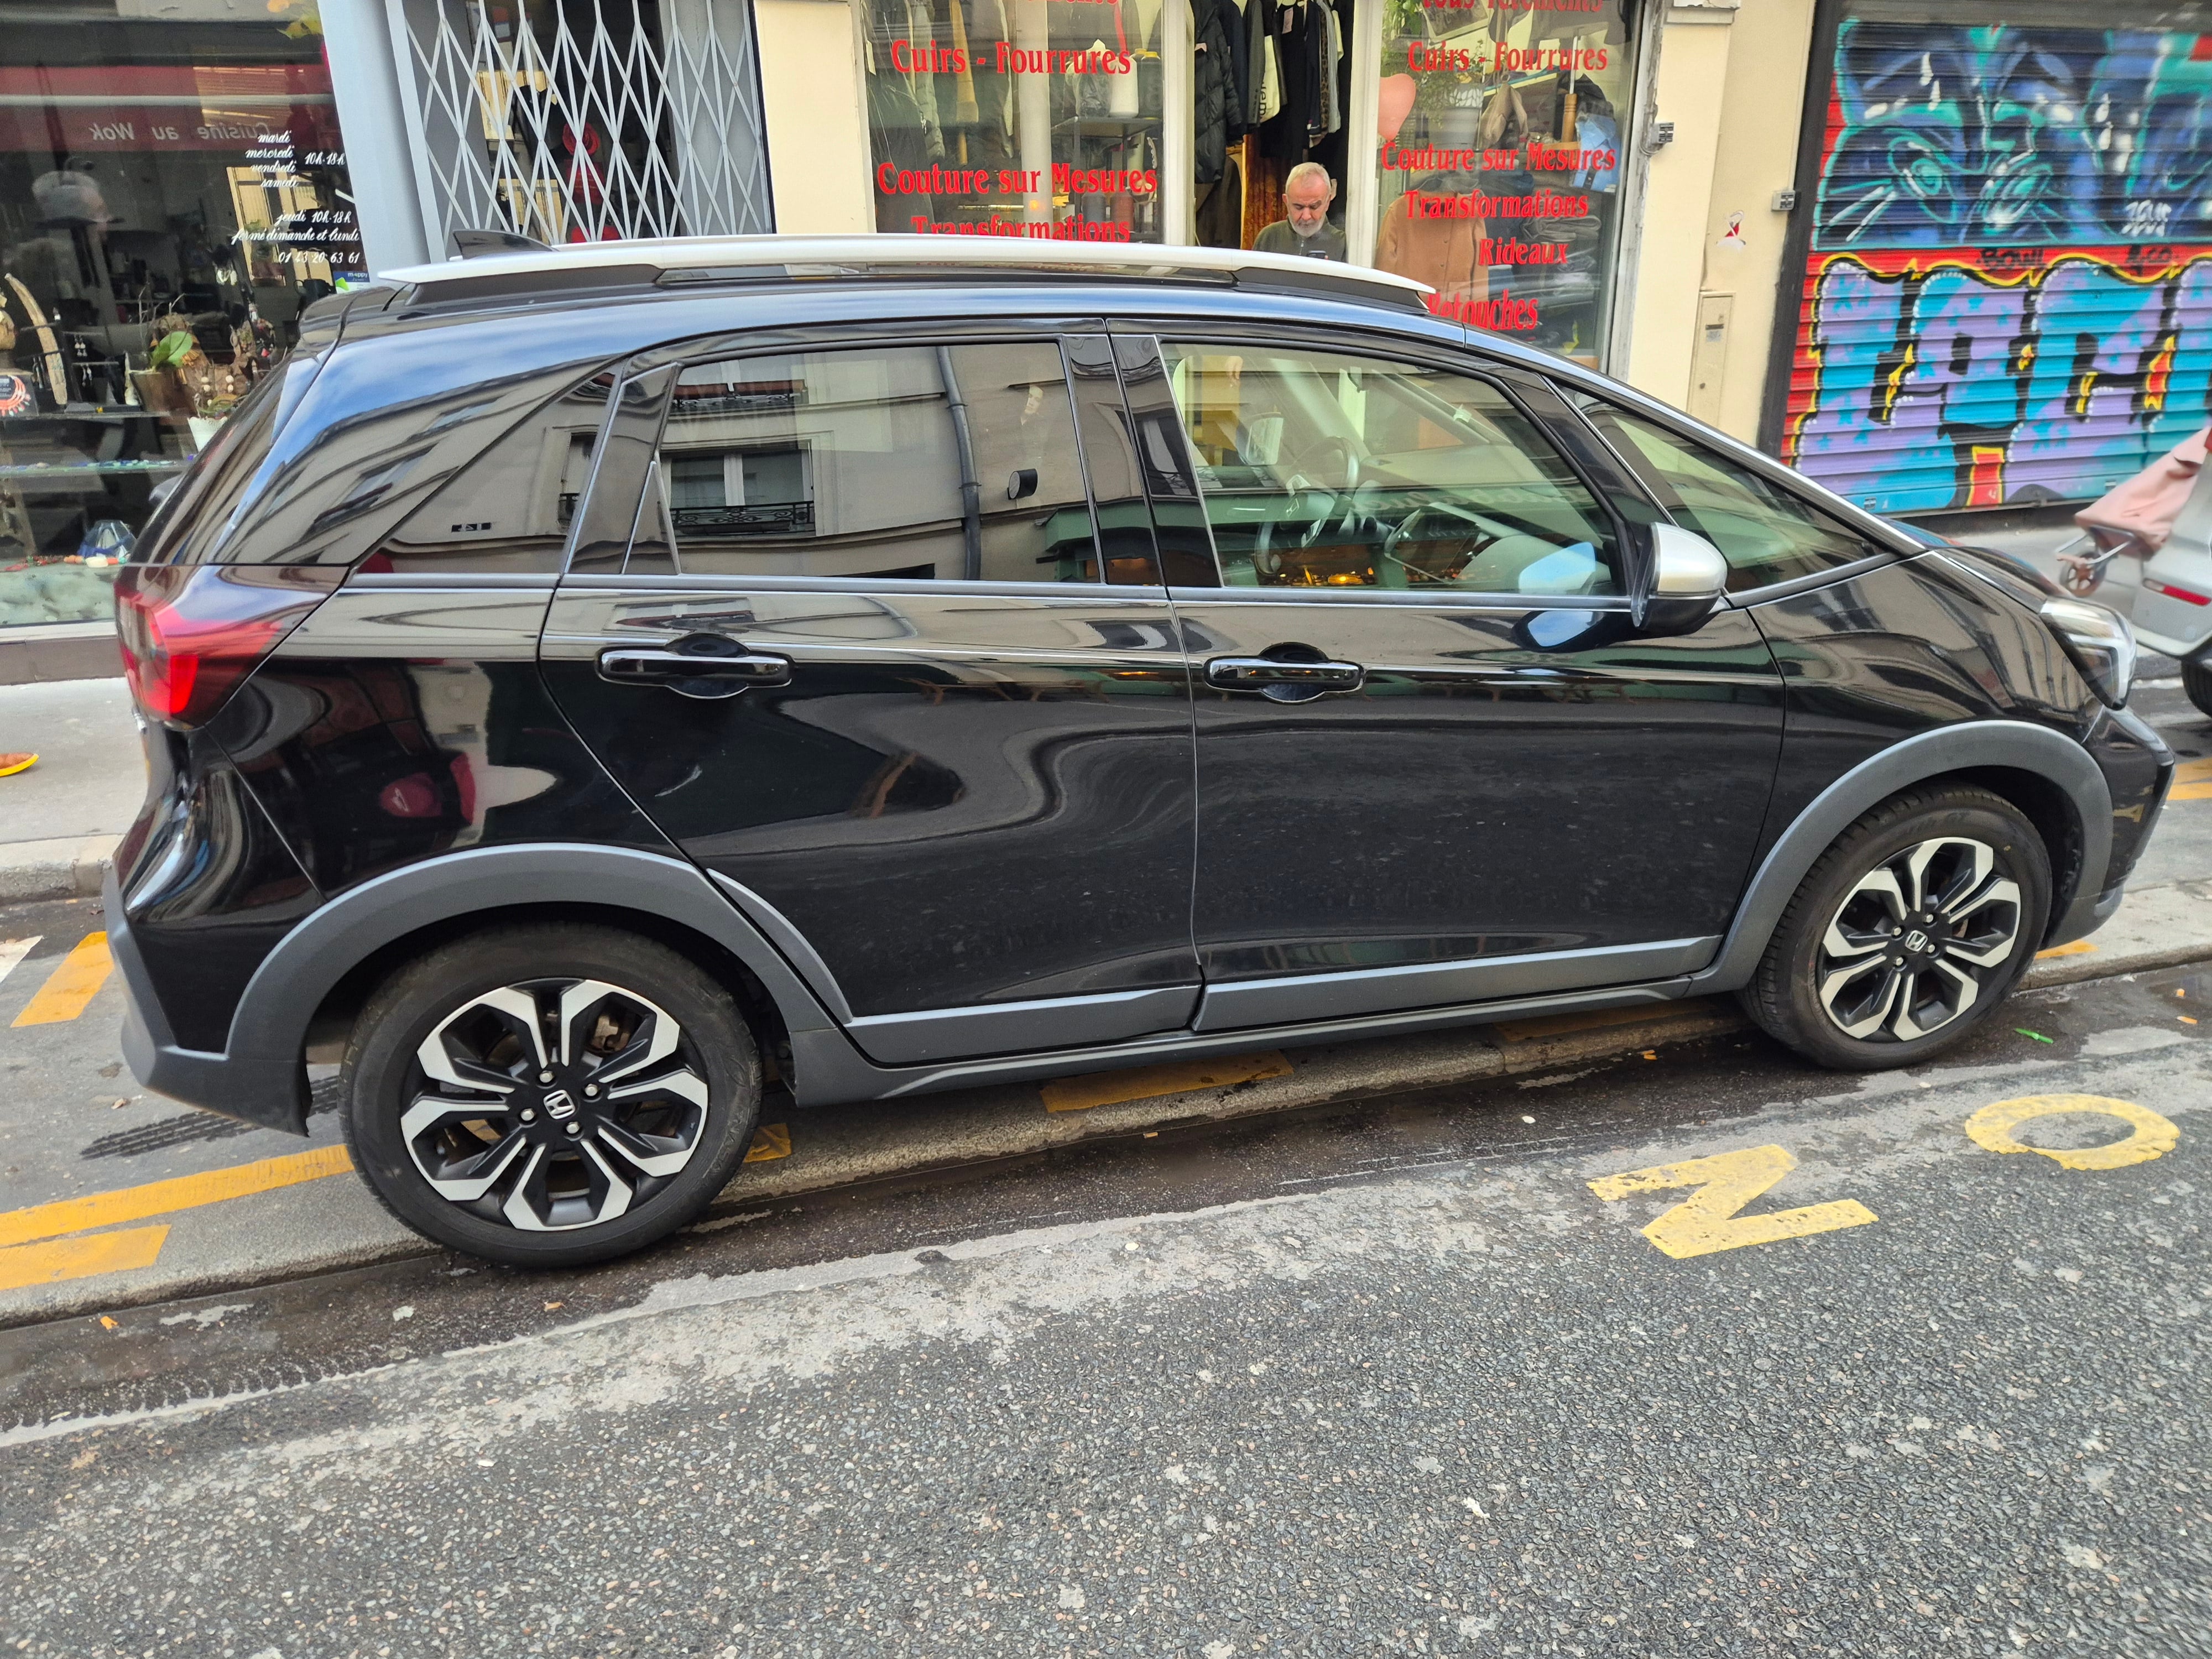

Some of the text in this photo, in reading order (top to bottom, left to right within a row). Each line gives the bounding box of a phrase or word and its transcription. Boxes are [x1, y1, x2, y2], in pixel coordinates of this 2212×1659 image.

[891, 39, 967, 74] Cuirs
[996, 41, 1131, 75] Fourrures
[1409, 42, 1470, 72] Cuirs
[1496, 43, 1608, 71] Fourrures
[257, 129, 293, 144] mardi
[244, 145, 295, 159] mercredi
[1382, 141, 1616, 171] Couture sur Mesures
[249, 159, 298, 173] vendredi
[260, 175, 299, 188] samedi
[878, 163, 1158, 195] Couture sur Mesures
[1405, 189, 1589, 220] Transformations
[274, 210, 306, 226] jeudi
[266, 226, 315, 242] dimanche
[316, 229, 326, 241] et
[328, 227, 360, 242] lundi
[278, 252, 292, 263] 01
[330, 252, 343, 264] 63
[348, 252, 361, 264] 61
[1479, 238, 1569, 266] Rideaux
